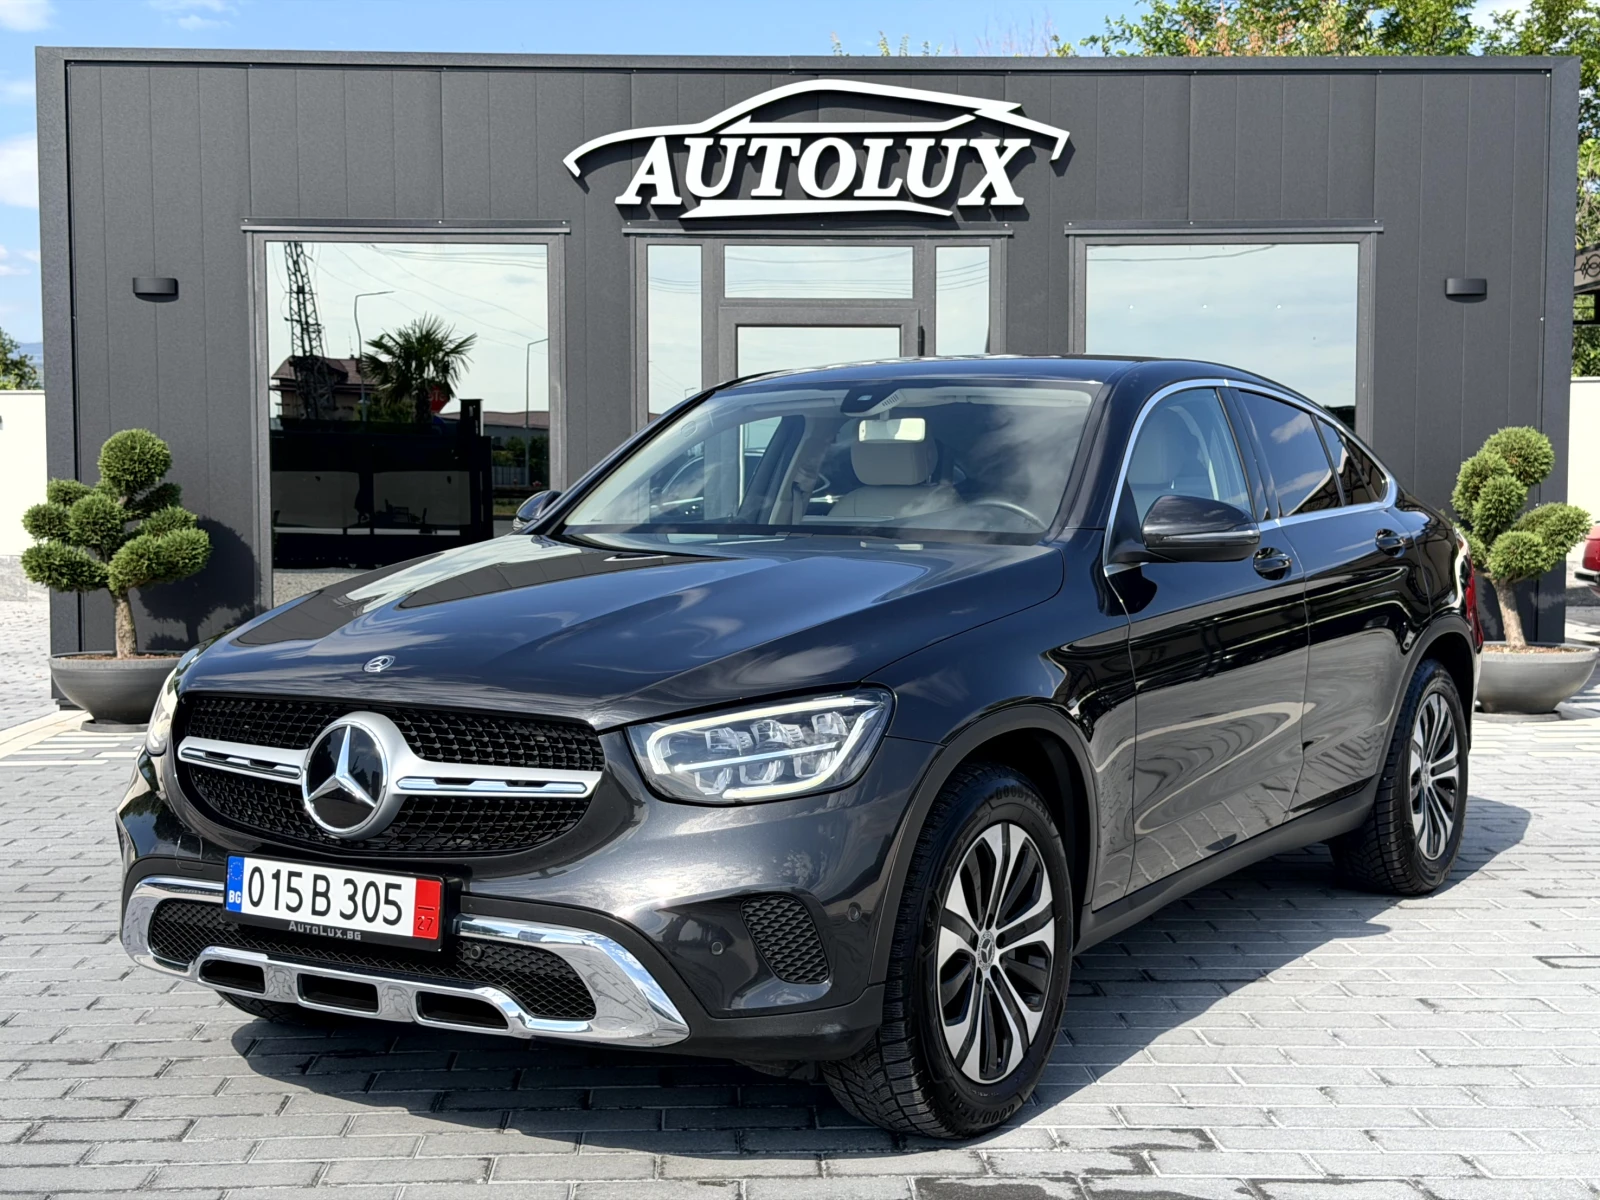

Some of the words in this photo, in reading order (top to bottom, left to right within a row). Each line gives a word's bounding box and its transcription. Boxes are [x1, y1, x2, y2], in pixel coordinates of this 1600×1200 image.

[616, 136, 1030, 206] AUTOLUX
[228, 890, 241, 904] BG
[417, 915, 434, 932] 27
